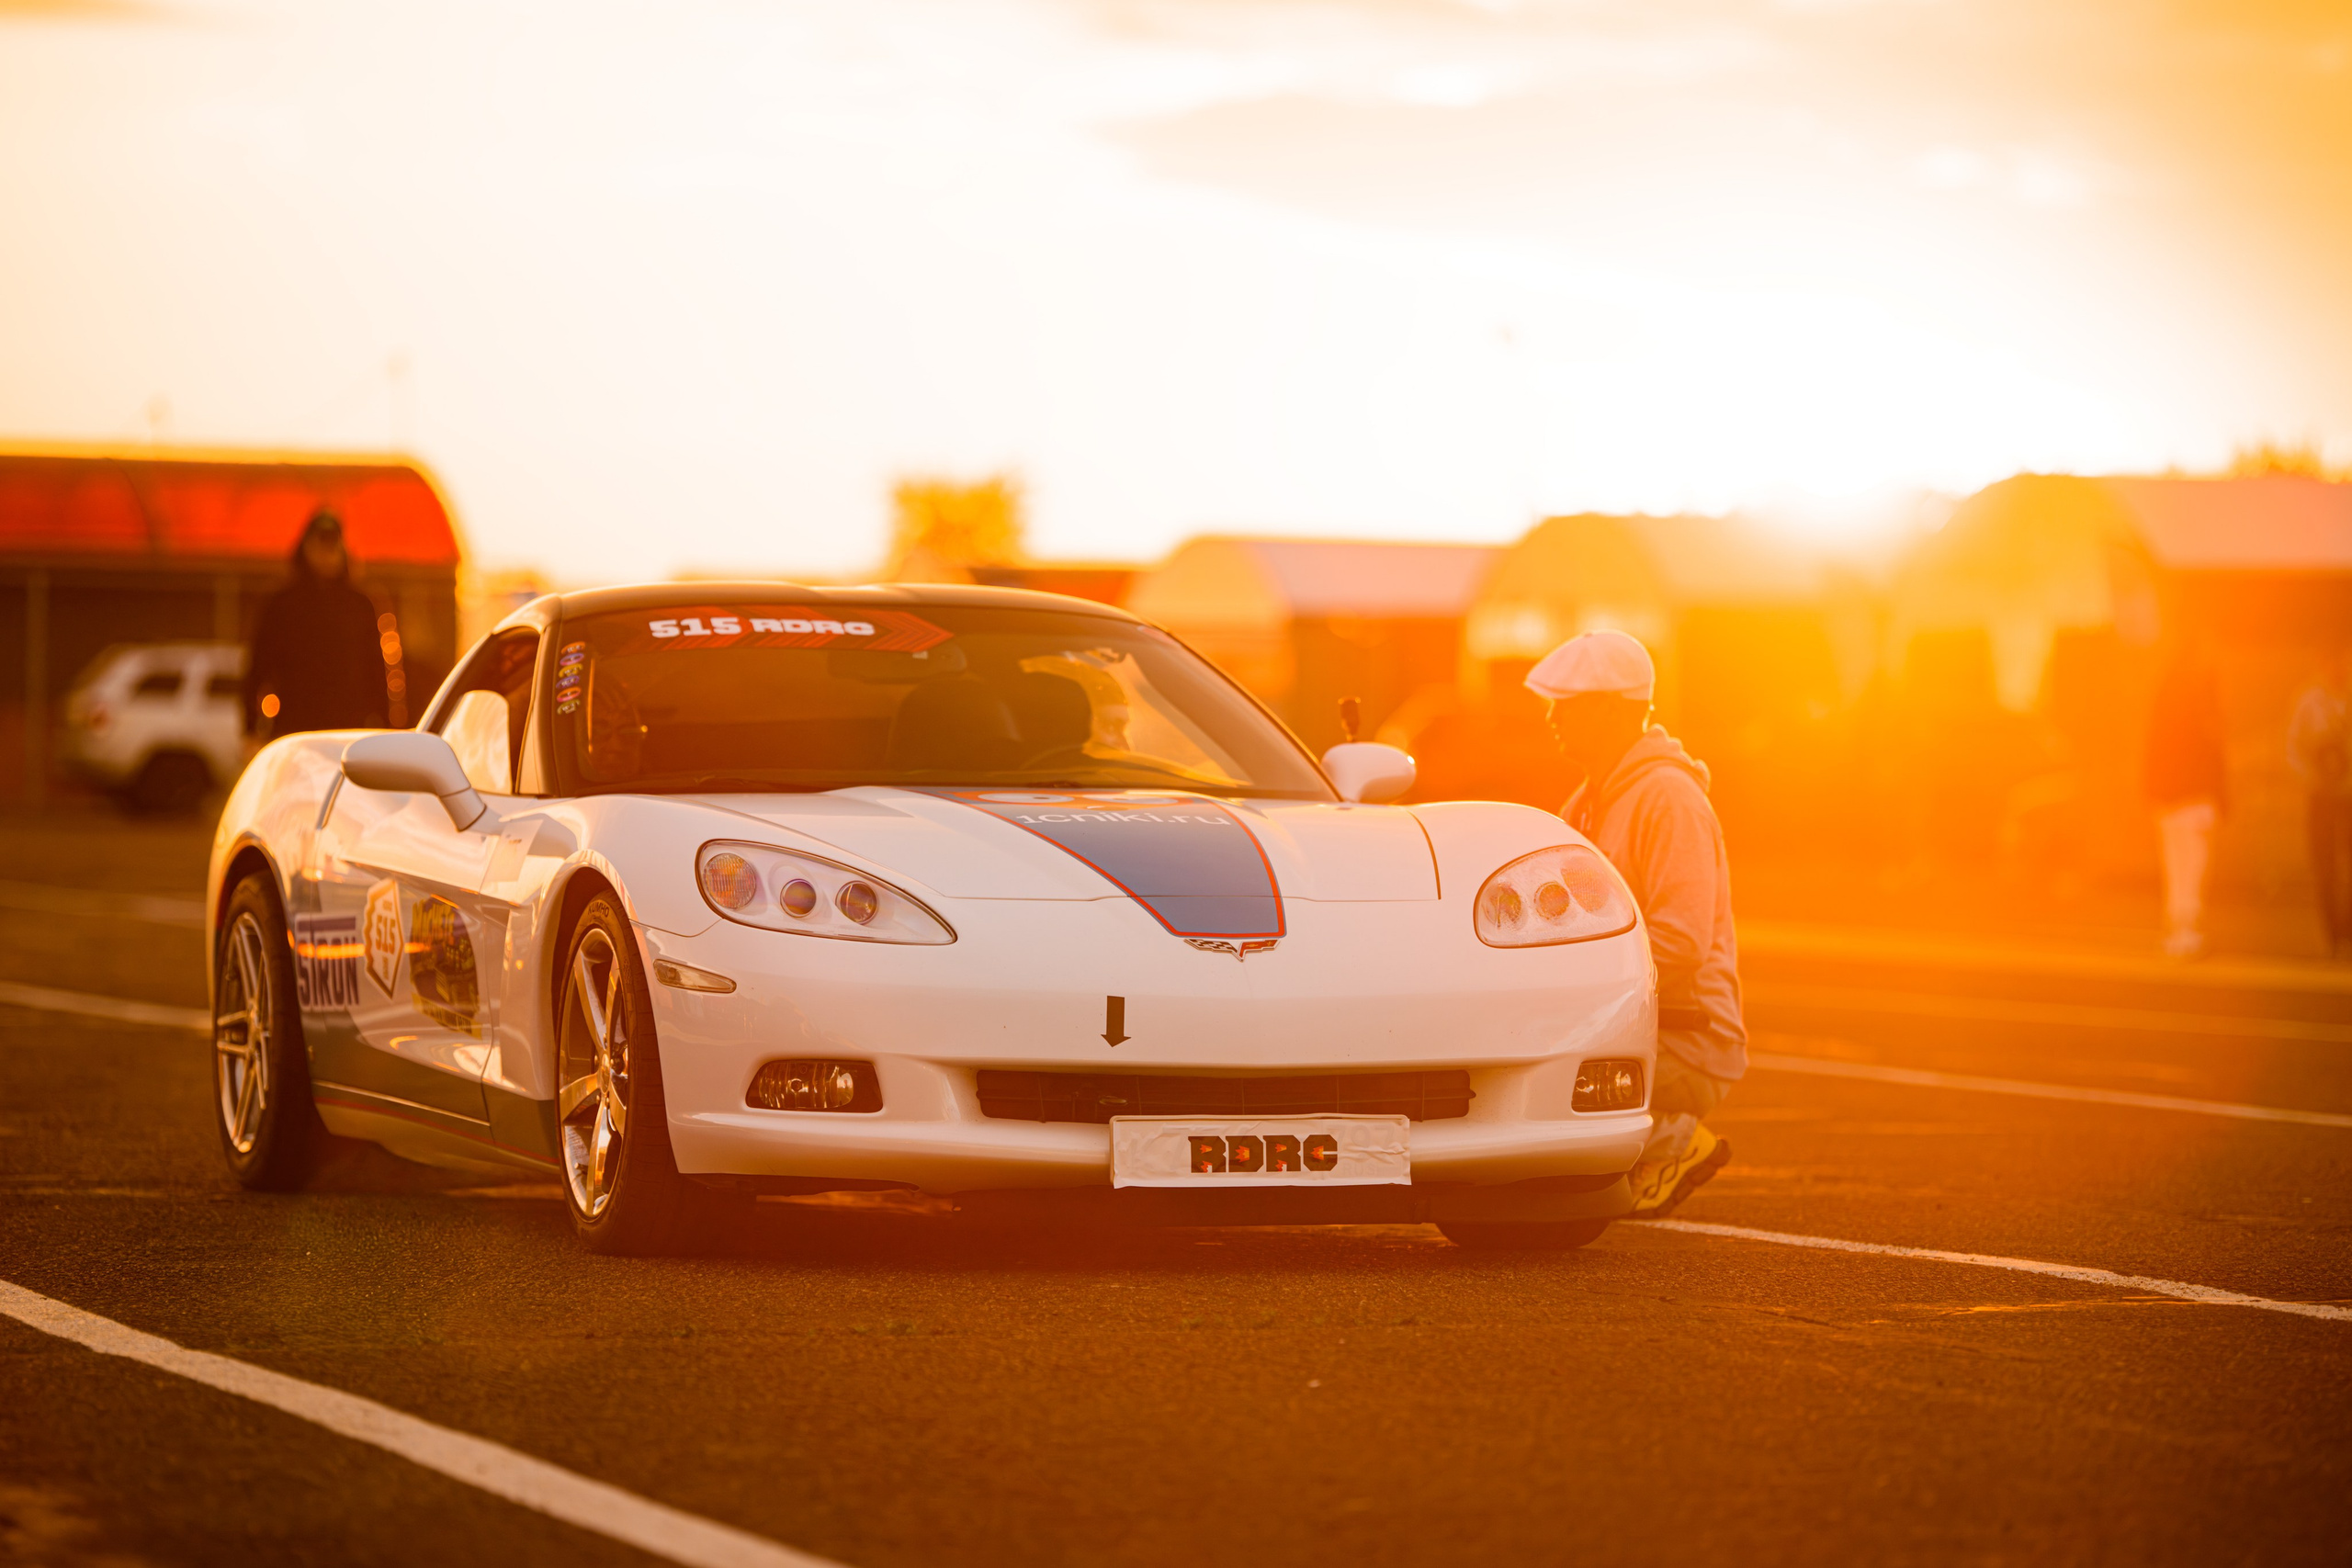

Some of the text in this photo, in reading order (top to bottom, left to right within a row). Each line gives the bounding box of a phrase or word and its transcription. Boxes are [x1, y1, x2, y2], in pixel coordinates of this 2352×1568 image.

[649, 616, 875, 638] 515 RDRC
[588, 901, 609, 918] KUMHO
[376, 914, 396, 954] 515
[1188, 1134, 1338, 1173] RDRC
